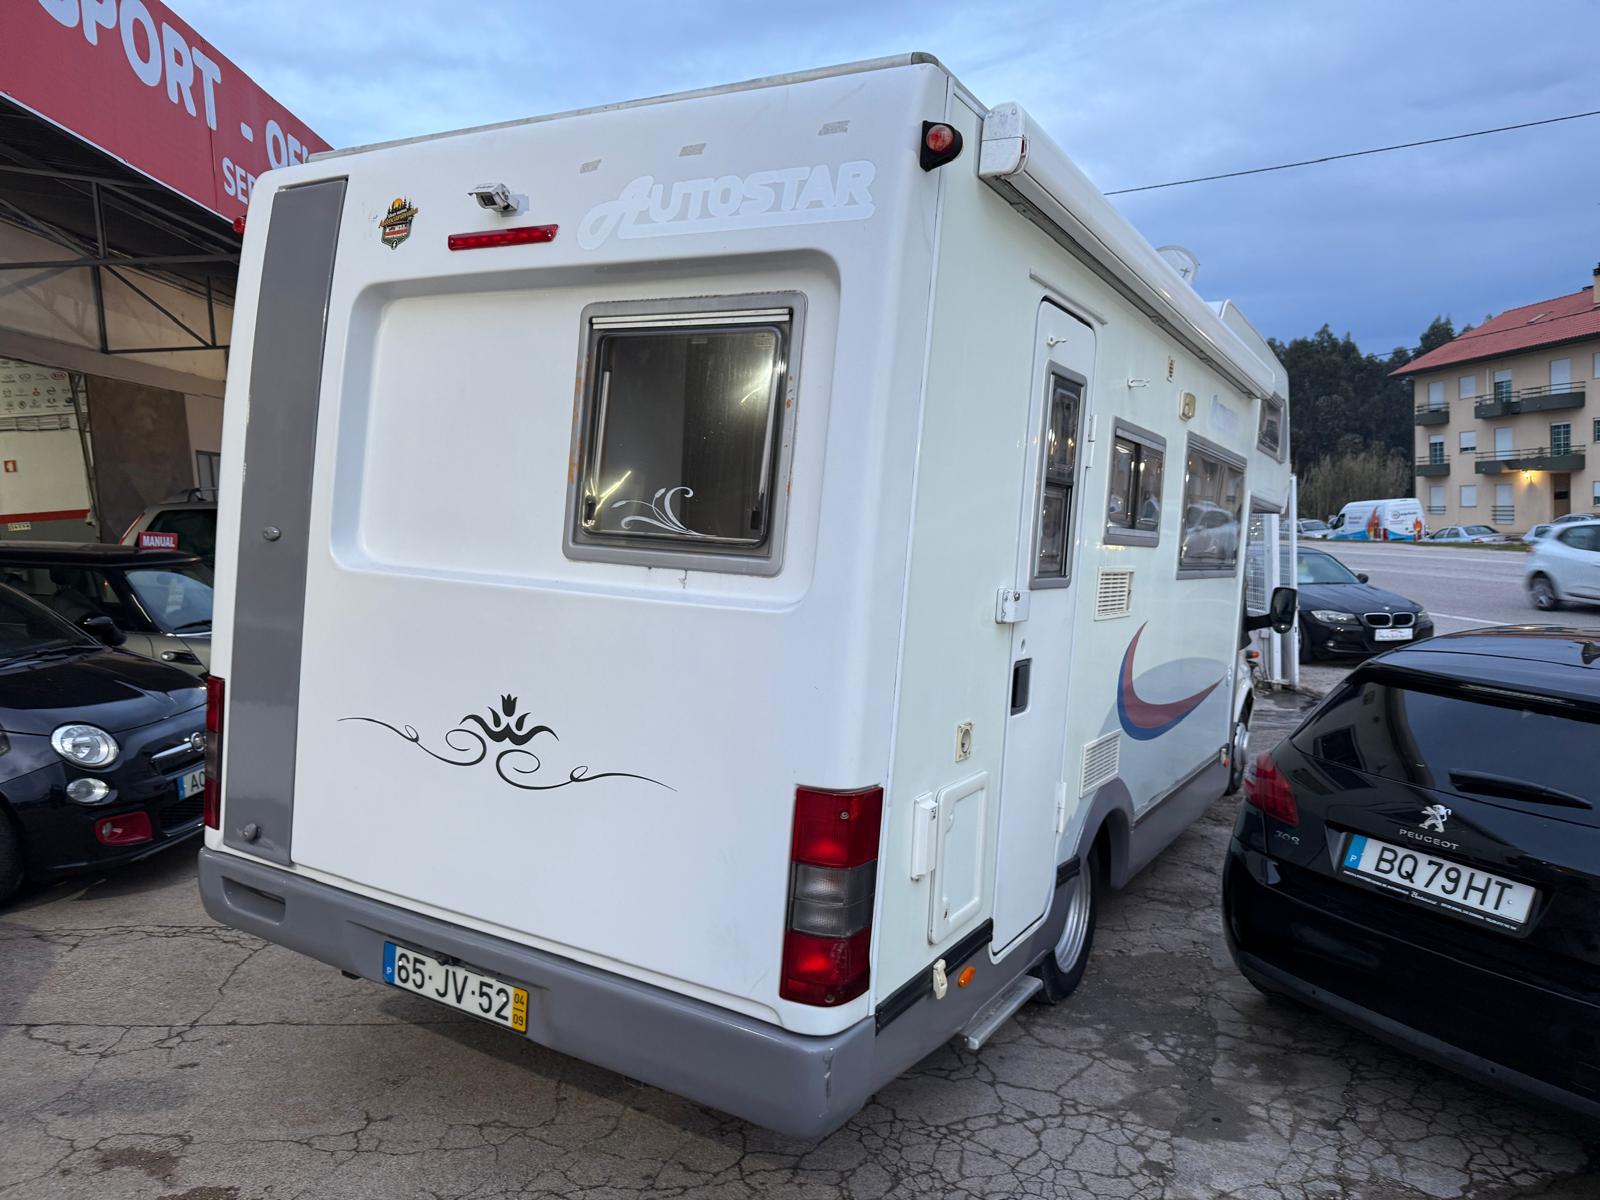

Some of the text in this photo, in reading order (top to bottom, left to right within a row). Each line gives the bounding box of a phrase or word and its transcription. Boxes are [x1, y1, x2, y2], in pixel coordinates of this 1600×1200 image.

[576, 159, 877, 250] AUTOSTAR
[143, 535, 176, 547] MANUAL
[1399, 828, 1460, 850] PEUGEOT
[1350, 854, 1357, 862] P
[513, 993, 525, 1006] 04
[512, 1014, 524, 1027] 09
